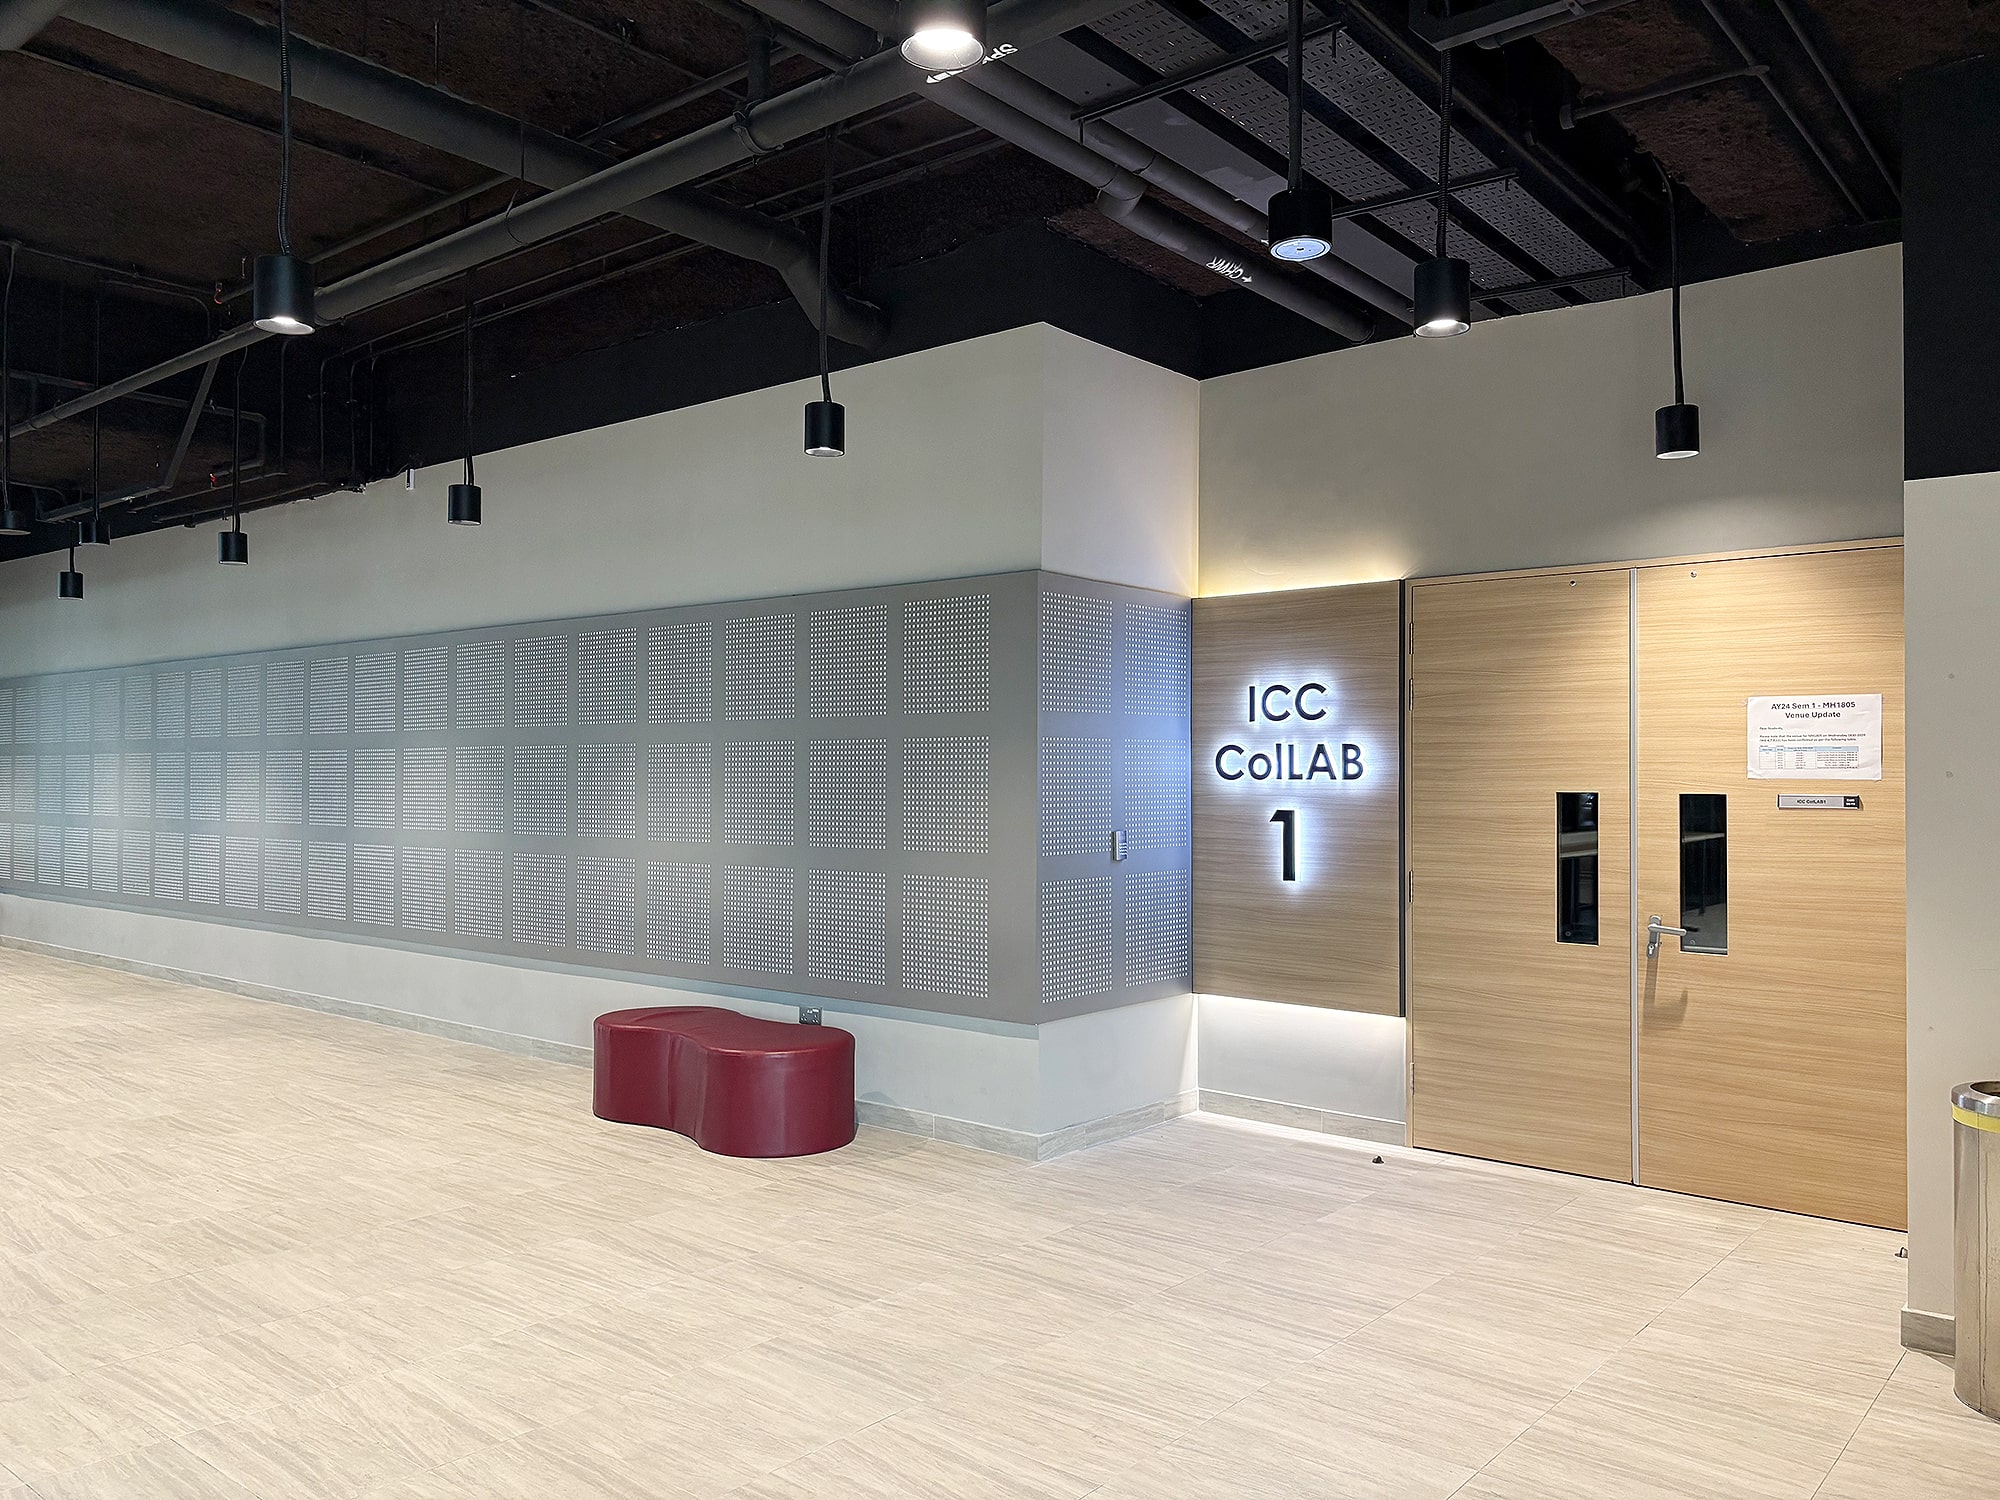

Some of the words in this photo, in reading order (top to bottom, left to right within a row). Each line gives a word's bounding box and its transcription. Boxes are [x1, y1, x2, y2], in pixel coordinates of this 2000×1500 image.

[1248, 682, 1327, 722] ICC
[1792, 702, 1810, 710] Sem
[1822, 701, 1856, 709] MH1805
[1811, 711, 1841, 719] Update
[1269, 809, 1296, 882] 1
